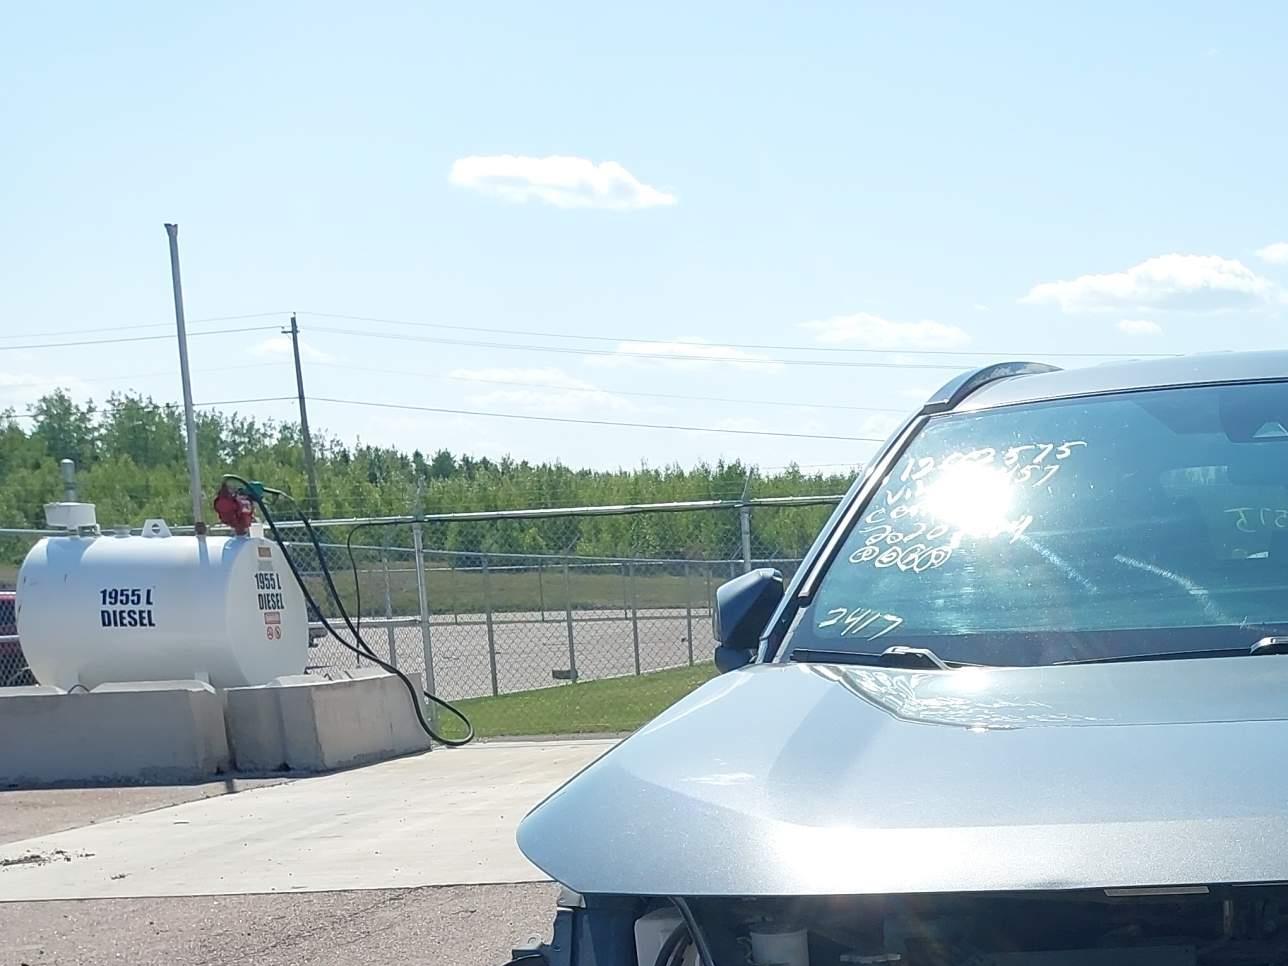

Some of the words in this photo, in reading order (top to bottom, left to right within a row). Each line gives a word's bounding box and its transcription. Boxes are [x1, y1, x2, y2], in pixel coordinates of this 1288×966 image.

[254, 572, 275, 590] 1955
[275, 572, 282, 590] L
[100, 588, 142, 606] 1955
[145, 588, 153, 606] L
[257, 593, 285, 610] DIESEL
[100, 609, 156, 628] DIESEL
[818, 607, 904, 642] 2417
